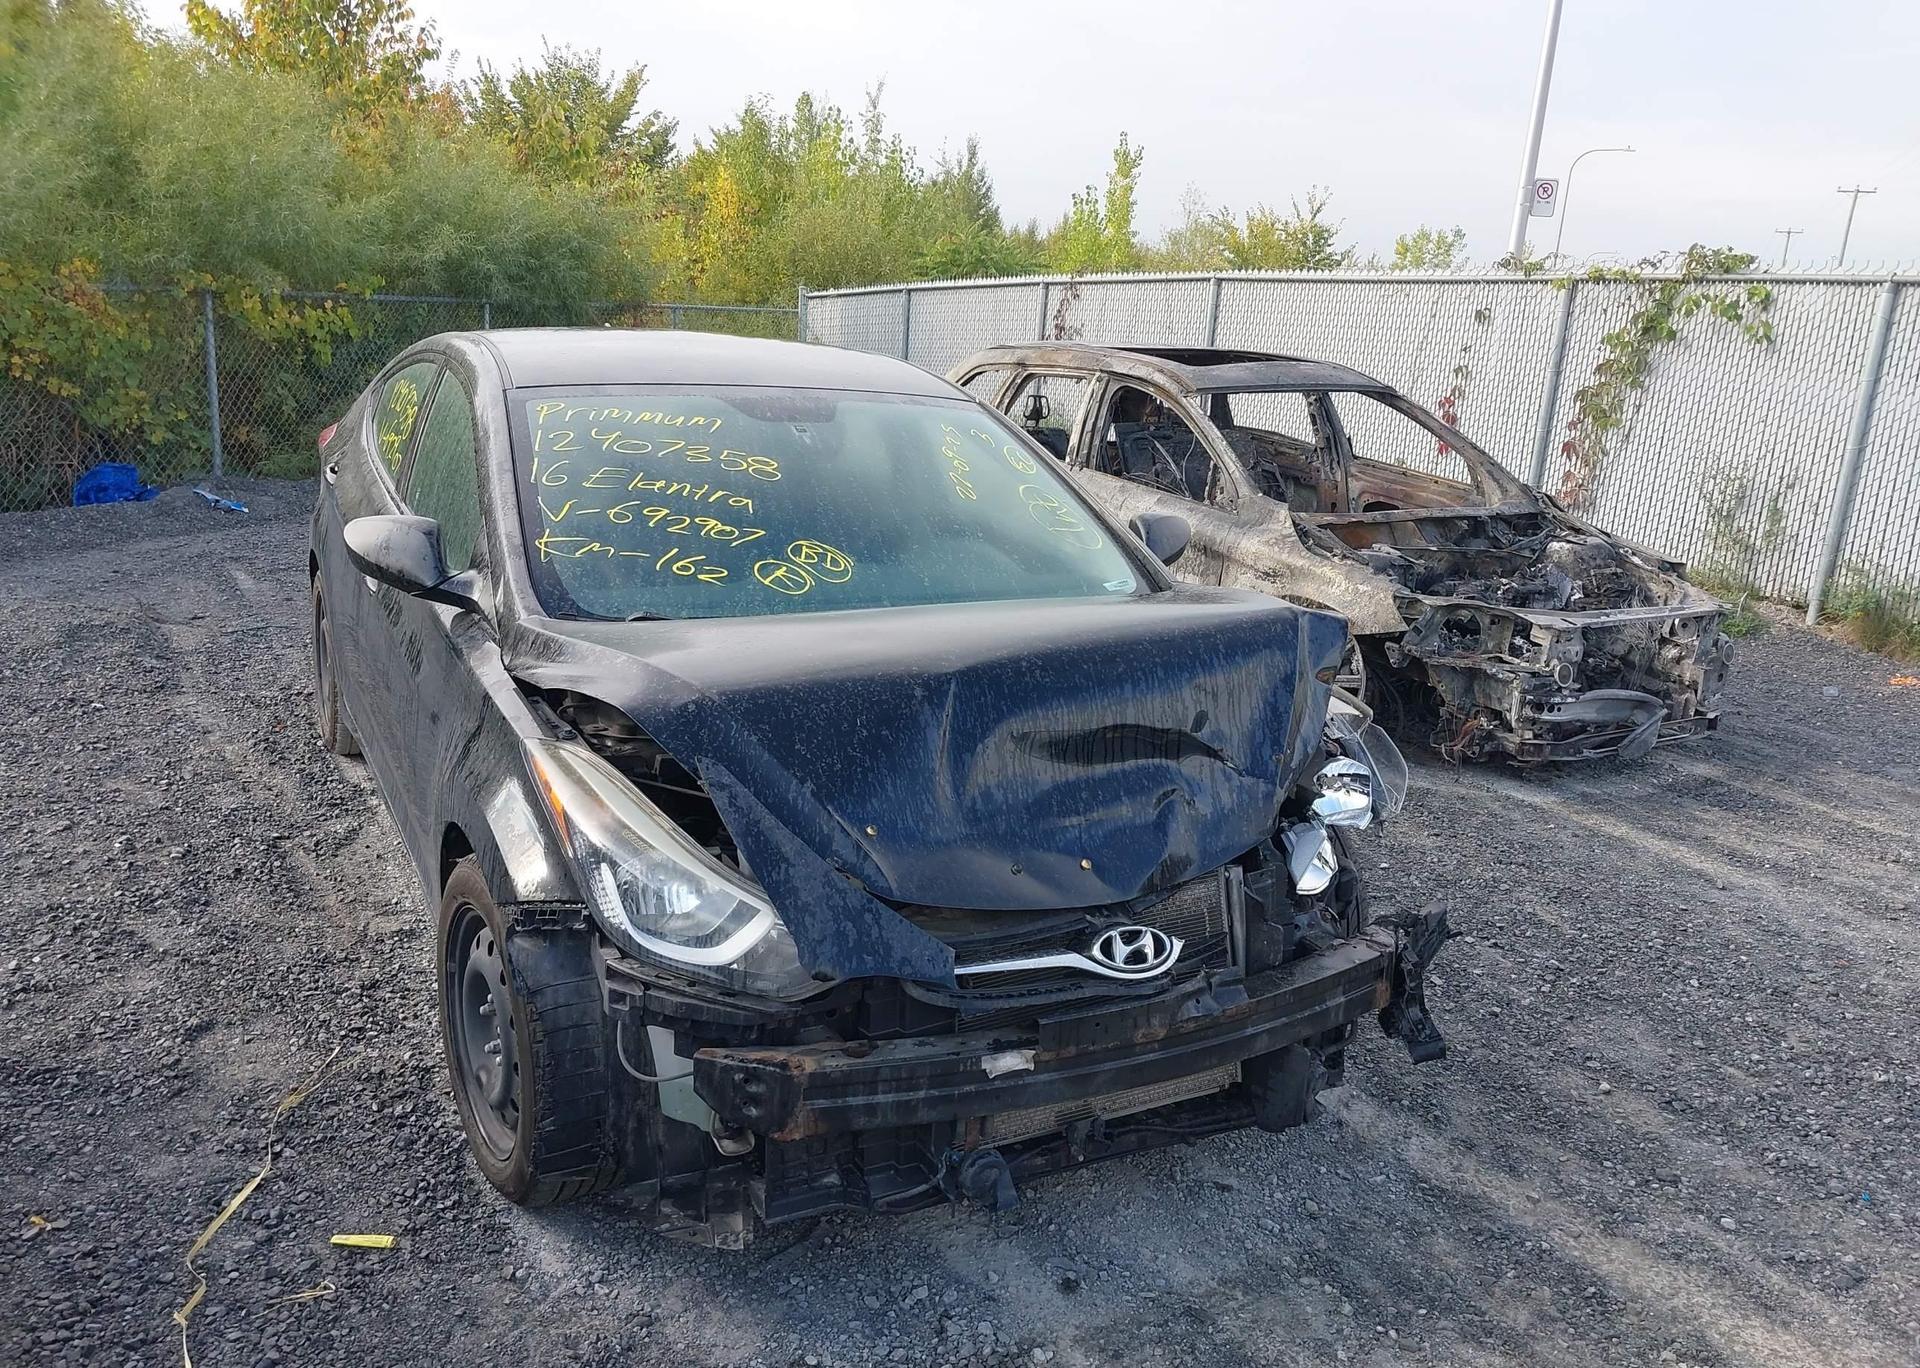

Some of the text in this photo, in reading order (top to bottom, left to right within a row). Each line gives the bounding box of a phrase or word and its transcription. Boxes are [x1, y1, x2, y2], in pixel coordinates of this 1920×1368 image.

[534, 428, 782, 481] 12407358
[530, 456, 754, 514] 16 Elantra
